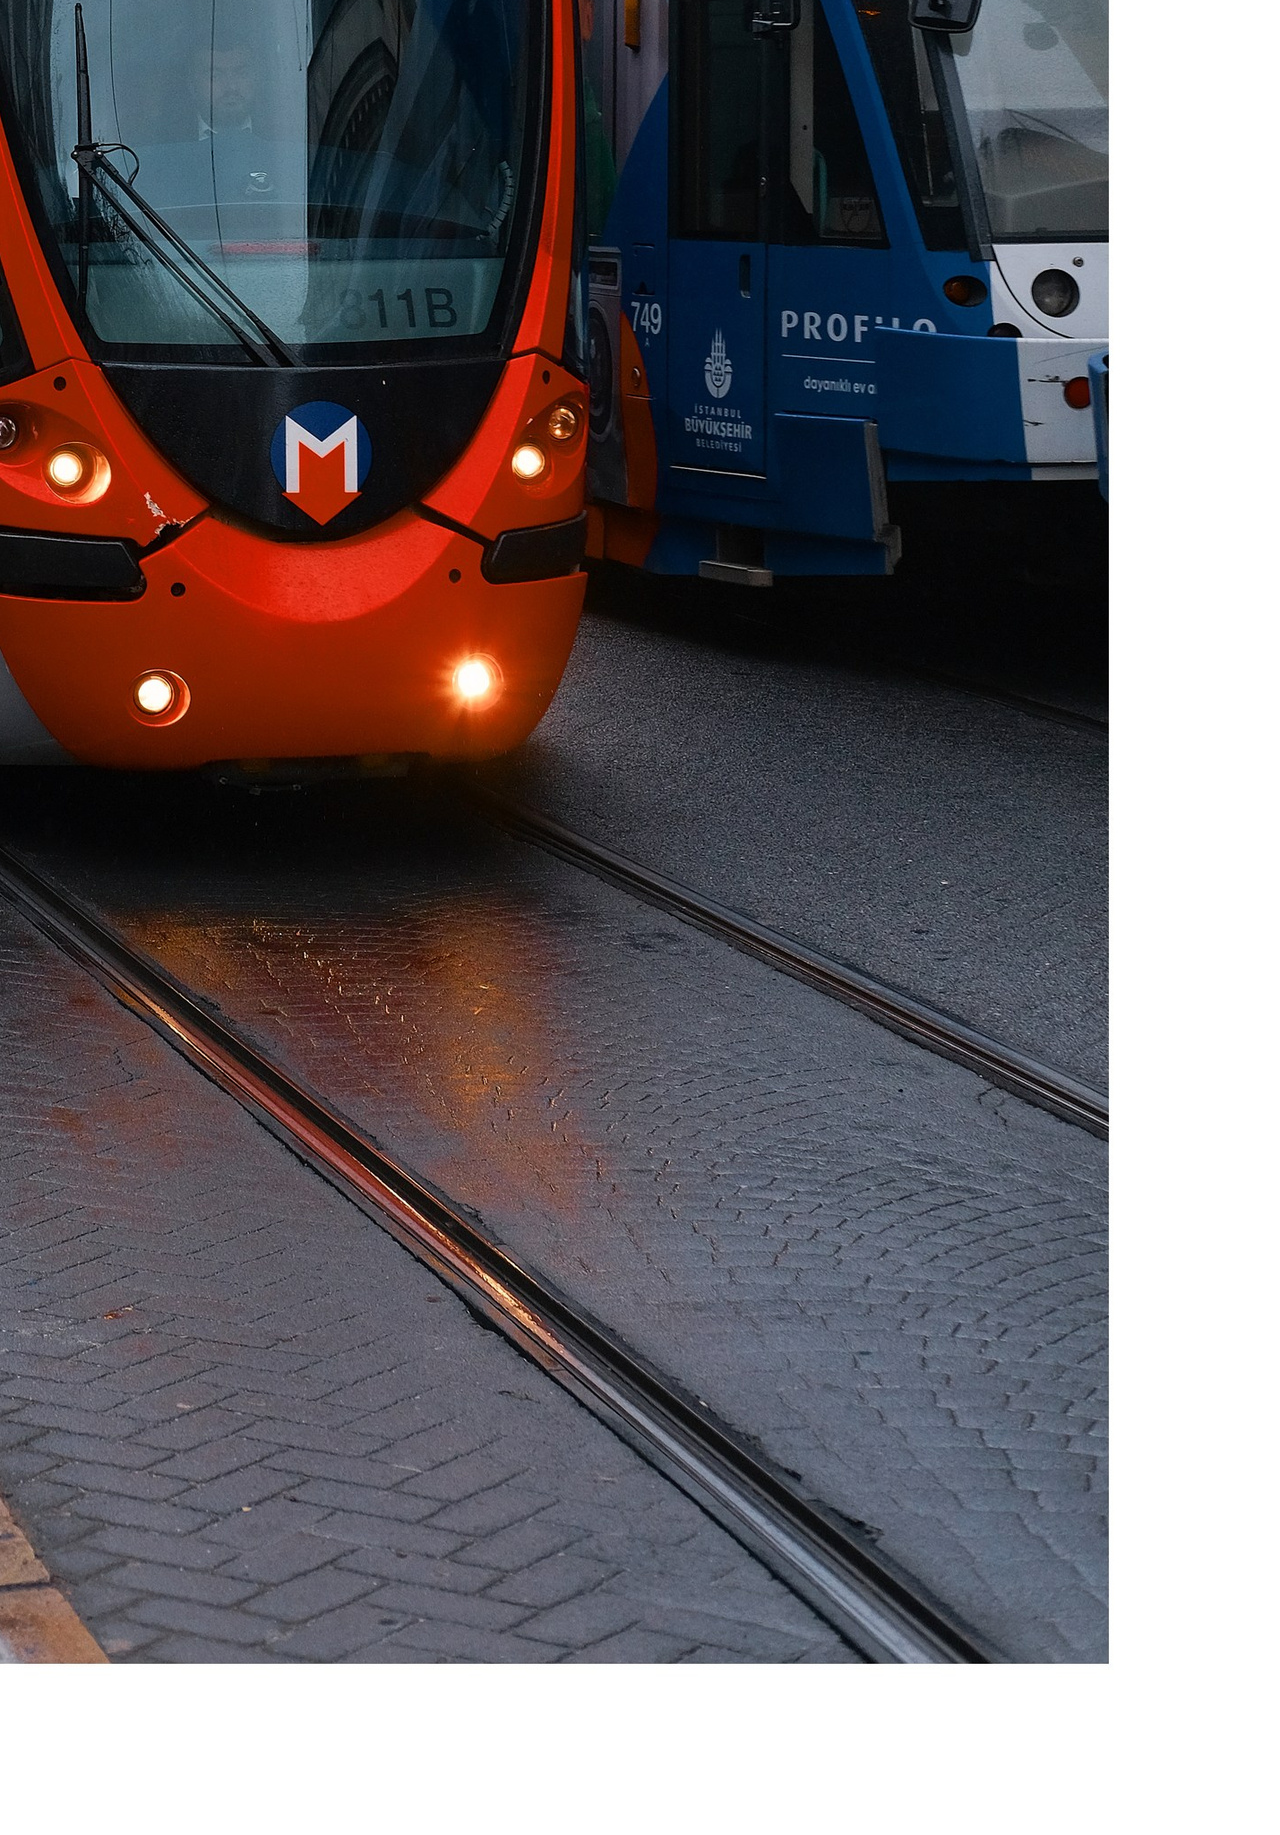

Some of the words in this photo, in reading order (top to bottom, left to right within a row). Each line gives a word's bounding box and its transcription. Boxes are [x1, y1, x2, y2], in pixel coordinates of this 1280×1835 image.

[339, 288, 458, 329] 811B
[631, 301, 662, 335] 749
[781, 310, 937, 343] PROF
[694, 403, 742, 419] İSTANBUL
[684, 415, 753, 440] BÜYÜKŞEHİR
[695, 437, 742, 453] BELEDİYESİ
